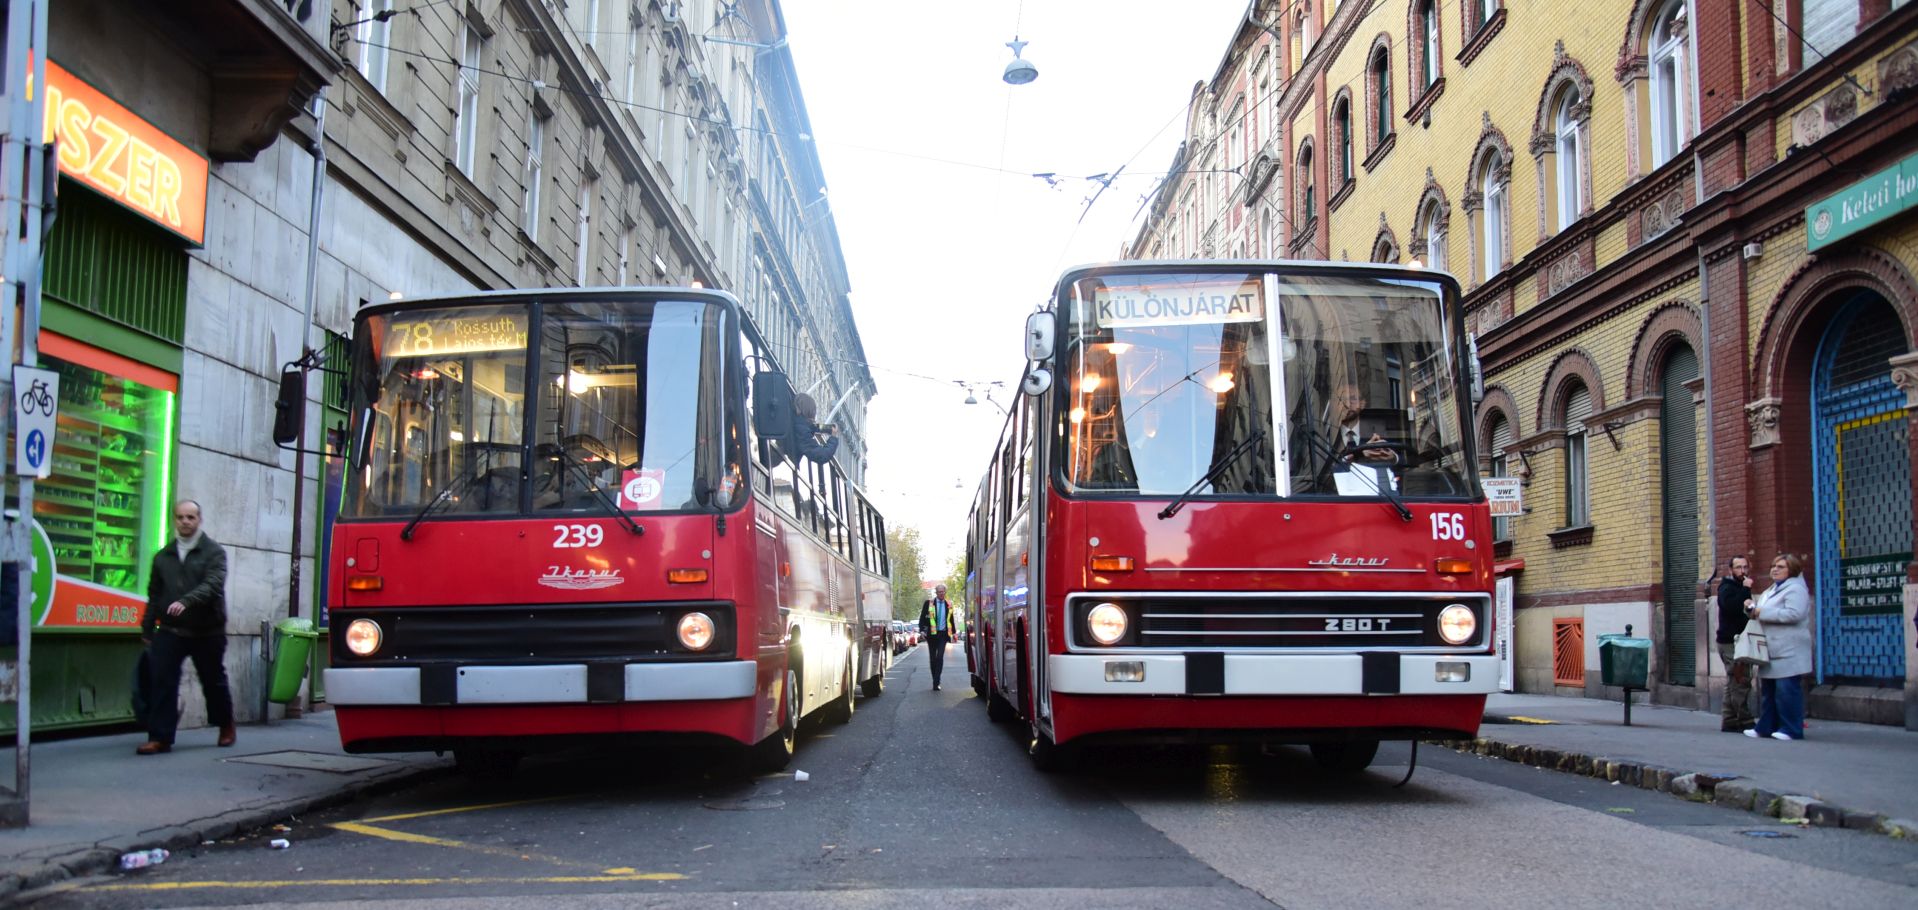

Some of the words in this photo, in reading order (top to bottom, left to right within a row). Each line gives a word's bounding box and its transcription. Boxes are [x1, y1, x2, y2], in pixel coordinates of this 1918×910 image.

[26, 74, 182, 227] ISZER
[1841, 179, 1889, 224] Keleti
[1896, 173, 1918, 199] ho
[1099, 292, 1254, 319] KÜLÖNJÁRAT
[391, 322, 433, 352] 78
[453, 317, 515, 336] Kossuth
[553, 524, 603, 548] 239
[1430, 512, 1464, 540] 156
[76, 604, 109, 623] RONI
[111, 606, 138, 623] ABC
[1377, 619, 1391, 631] T
